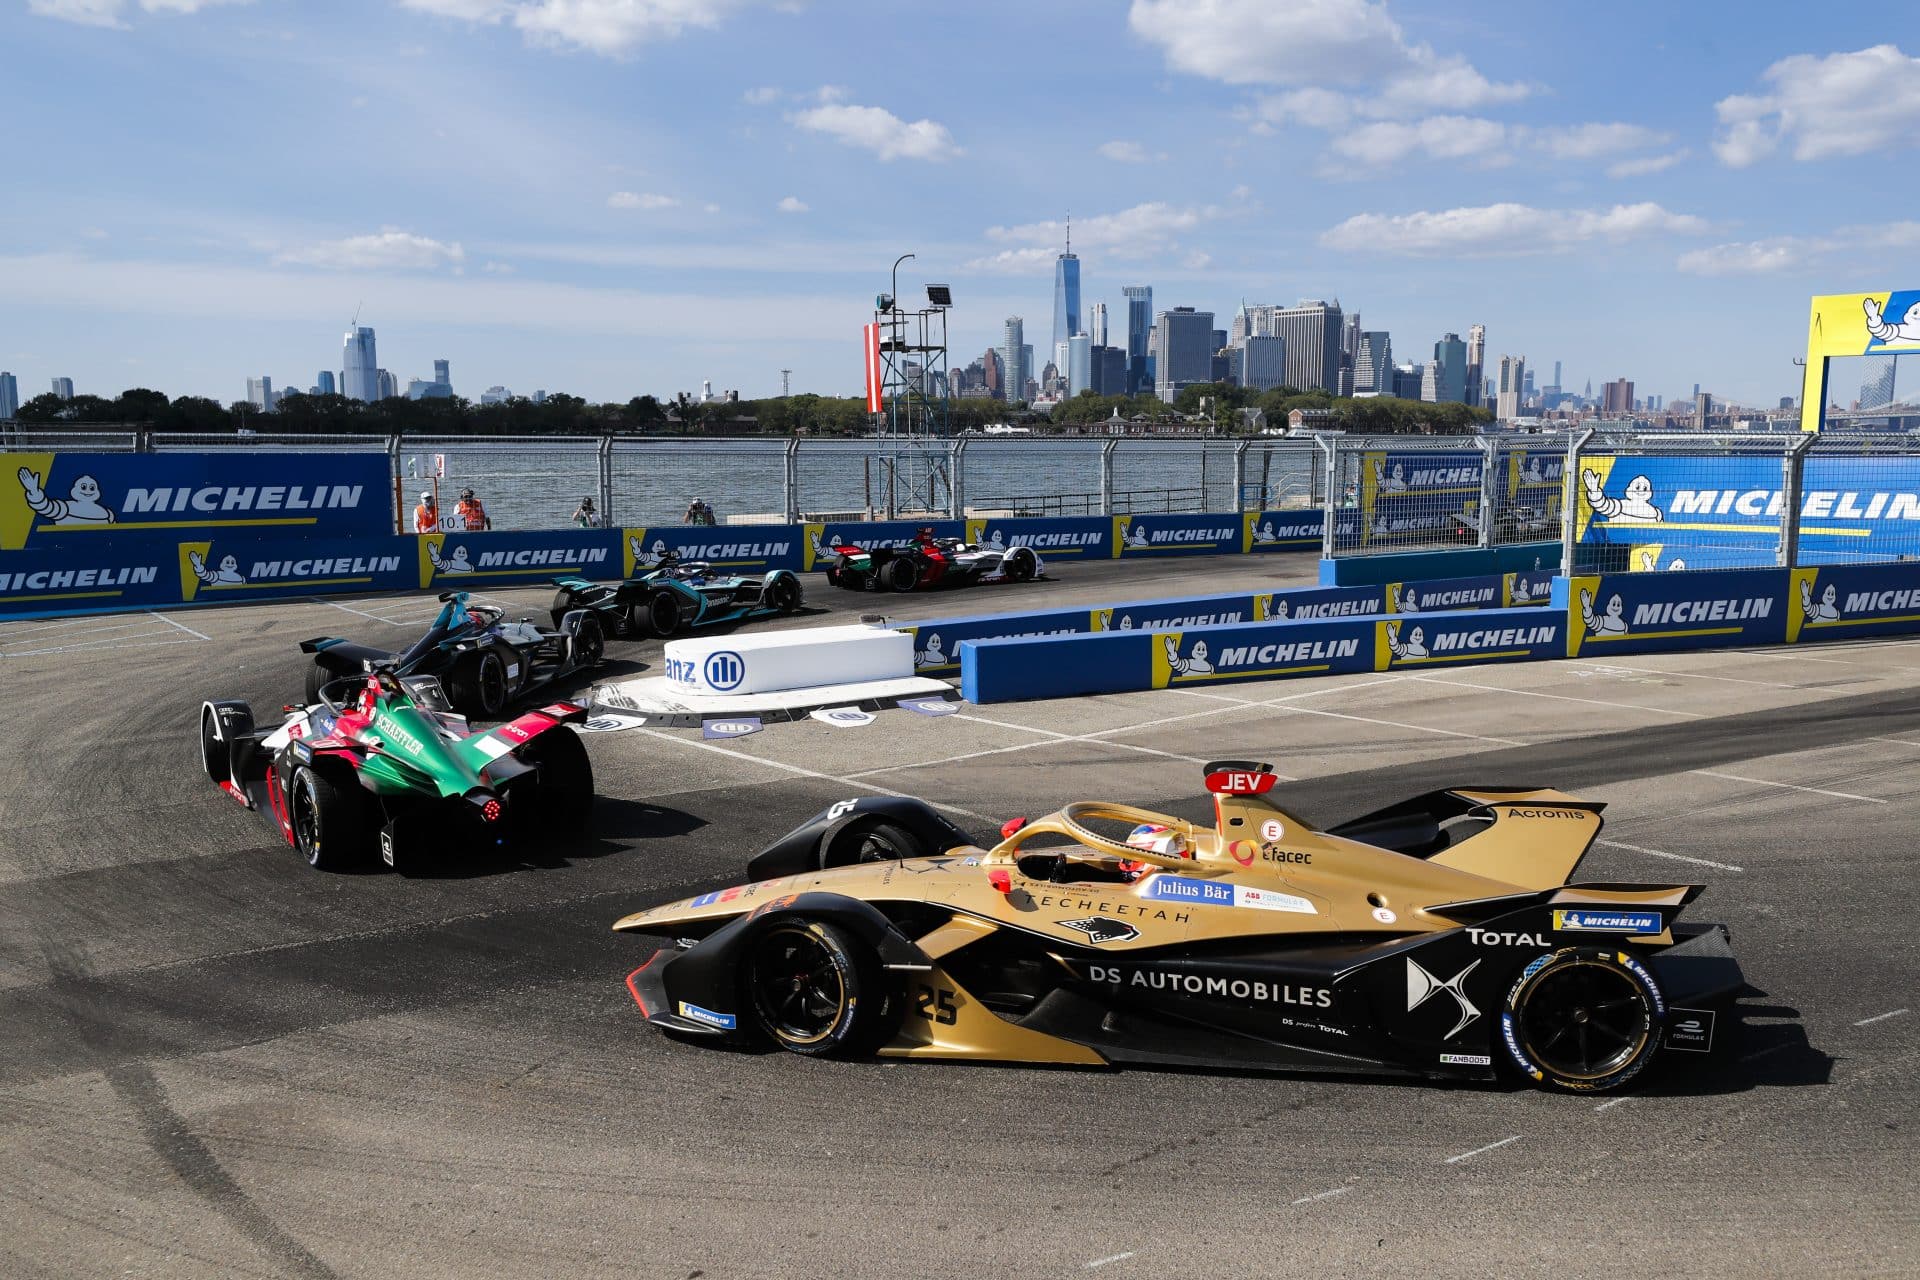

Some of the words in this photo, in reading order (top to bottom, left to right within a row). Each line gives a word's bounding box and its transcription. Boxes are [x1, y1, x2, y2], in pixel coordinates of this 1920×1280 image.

[122, 485, 363, 512] MICHELIN
[1009, 532, 1102, 546] MICHELIN
[1151, 528, 1236, 543] MICHELIN
[478, 547, 609, 567] MICHELIN
[677, 542, 790, 560] MICHELIN
[250, 555, 401, 579] MICHELIN
[1421, 587, 1495, 607] MICHELIN
[1843, 589, 1920, 613] MICHE
[1295, 599, 1380, 619] MICHELIN
[1633, 597, 1774, 626] MICHELIN
[1433, 626, 1557, 651] MICHELIN
[1218, 638, 1360, 667] MICHELIN
[376, 713, 424, 757] SCHAEFFLER
[1221, 773, 1263, 791] JEV
[1508, 808, 1585, 820] Acronis
[1157, 880, 1199, 897] Julius
[1203, 880, 1232, 900] Bär
[1245, 892, 1261, 900] ABB
[1025, 894, 1190, 923] TECHEETAH
[1583, 917, 1652, 928] MICHELIN
[1464, 928, 1552, 947] TOTAL
[1089, 965, 1122, 985] DS
[1130, 970, 1332, 1009] AUTOMOBILES
[1634, 965, 1665, 1013] MICHELIN
[915, 985, 957, 1026] 25
[693, 1010, 730, 1025] MICHELIN
[1318, 1024, 1349, 1036] TOTAL
[1503, 1018, 1529, 1067] MICHELIN
